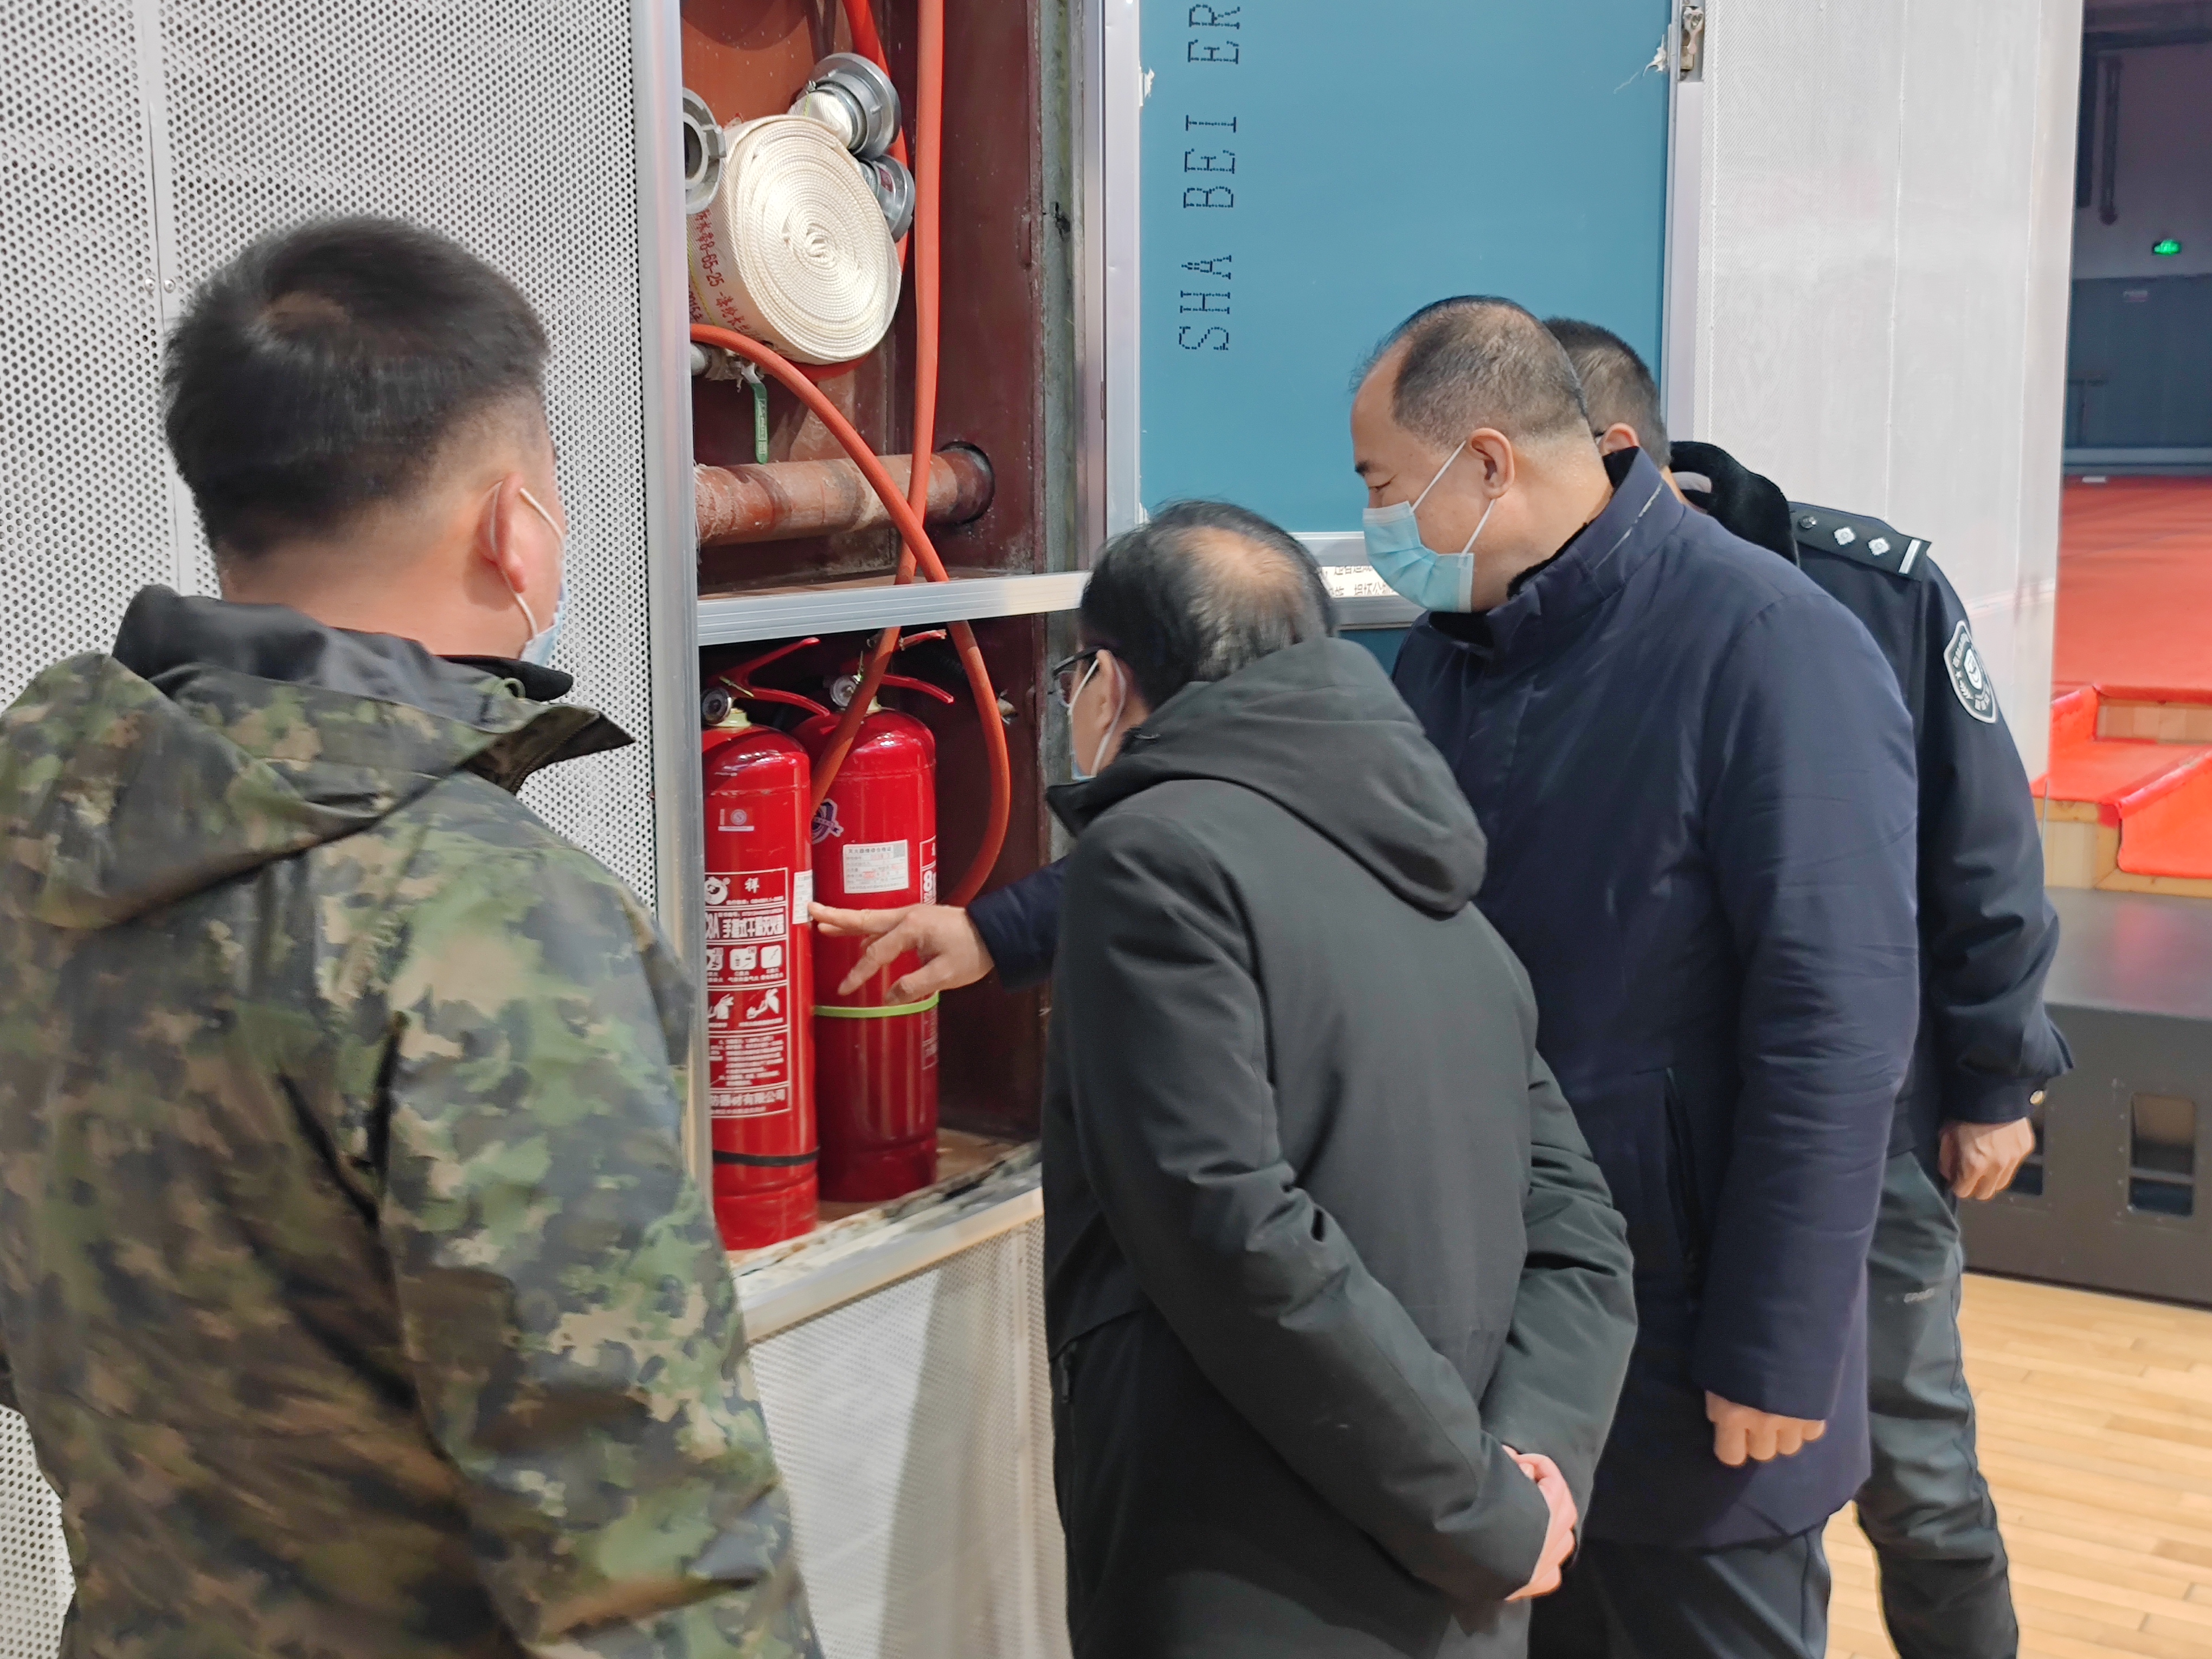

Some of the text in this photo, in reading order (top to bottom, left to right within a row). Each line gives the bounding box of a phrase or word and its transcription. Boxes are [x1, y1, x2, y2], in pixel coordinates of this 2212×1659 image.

[1179, 4, 1241, 351] SHA BEI ER
